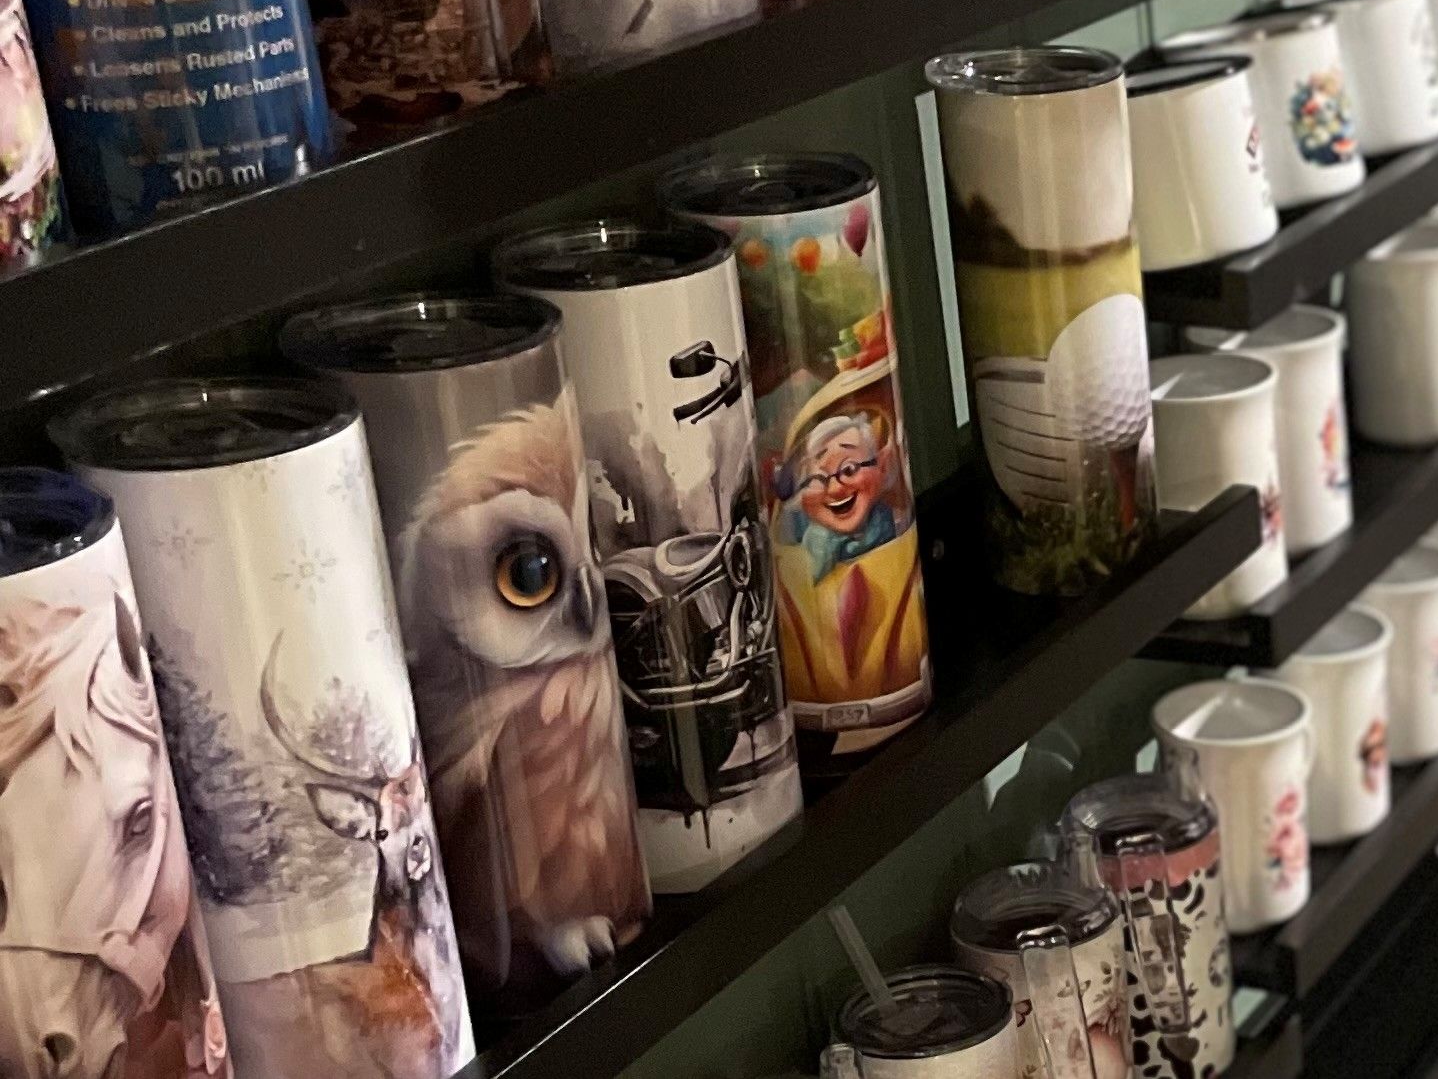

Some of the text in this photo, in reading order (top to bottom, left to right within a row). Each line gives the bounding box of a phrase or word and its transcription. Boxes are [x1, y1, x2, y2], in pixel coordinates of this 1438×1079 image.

[173, 16, 211, 37] and
[216, 3, 284, 31] Protects
[186, 44, 255, 71] Rusted
[259, 36, 296, 58] Parts
[143, 85, 208, 111] Sticky
[172, 160, 266, 194] 100 ml
